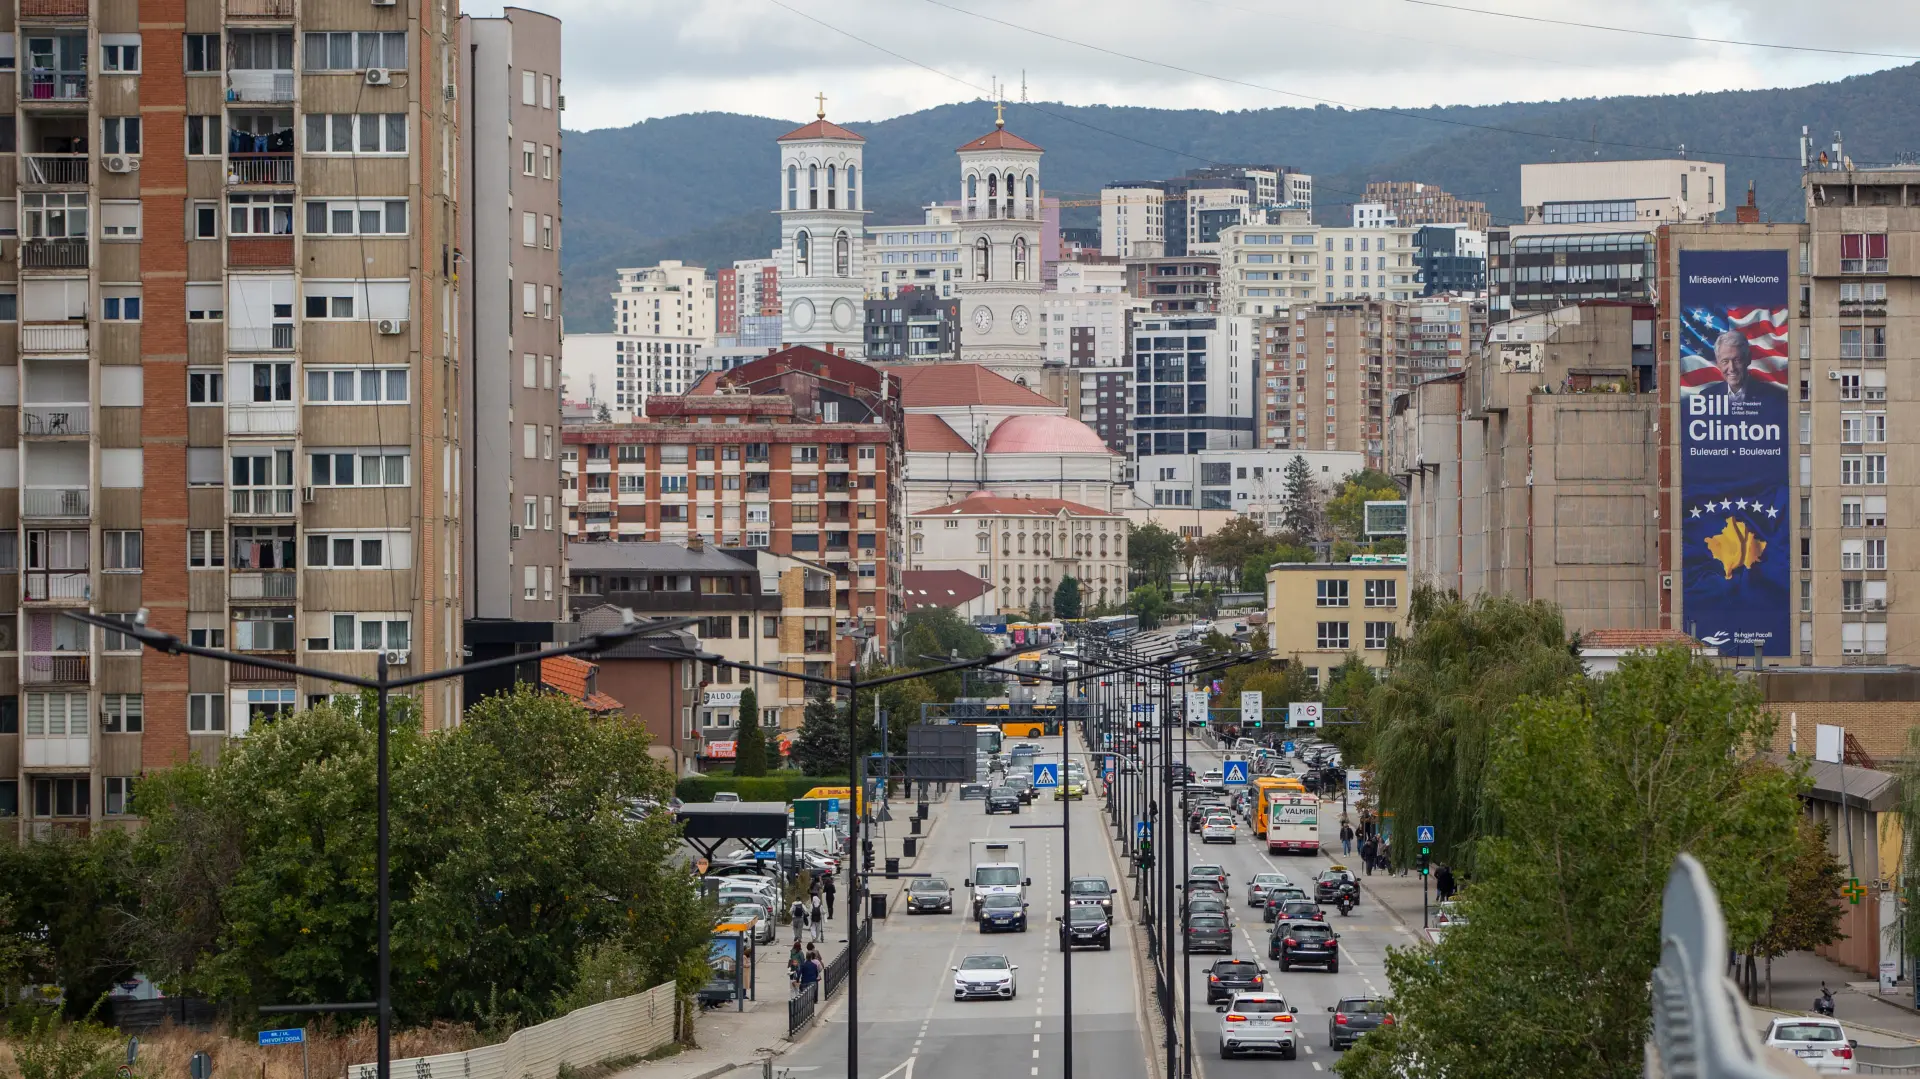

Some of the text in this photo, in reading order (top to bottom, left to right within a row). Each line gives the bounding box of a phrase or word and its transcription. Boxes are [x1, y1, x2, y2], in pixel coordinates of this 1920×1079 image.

[1739, 274, 1779, 283] Welcome
[1689, 394, 1729, 416] Bill
[1689, 419, 1781, 441] Clinton
[1690, 447, 1781, 456] Bulevardi Boulevard
[710, 692, 731, 700] ALDO
[1284, 807, 1316, 815] VALMIRI
